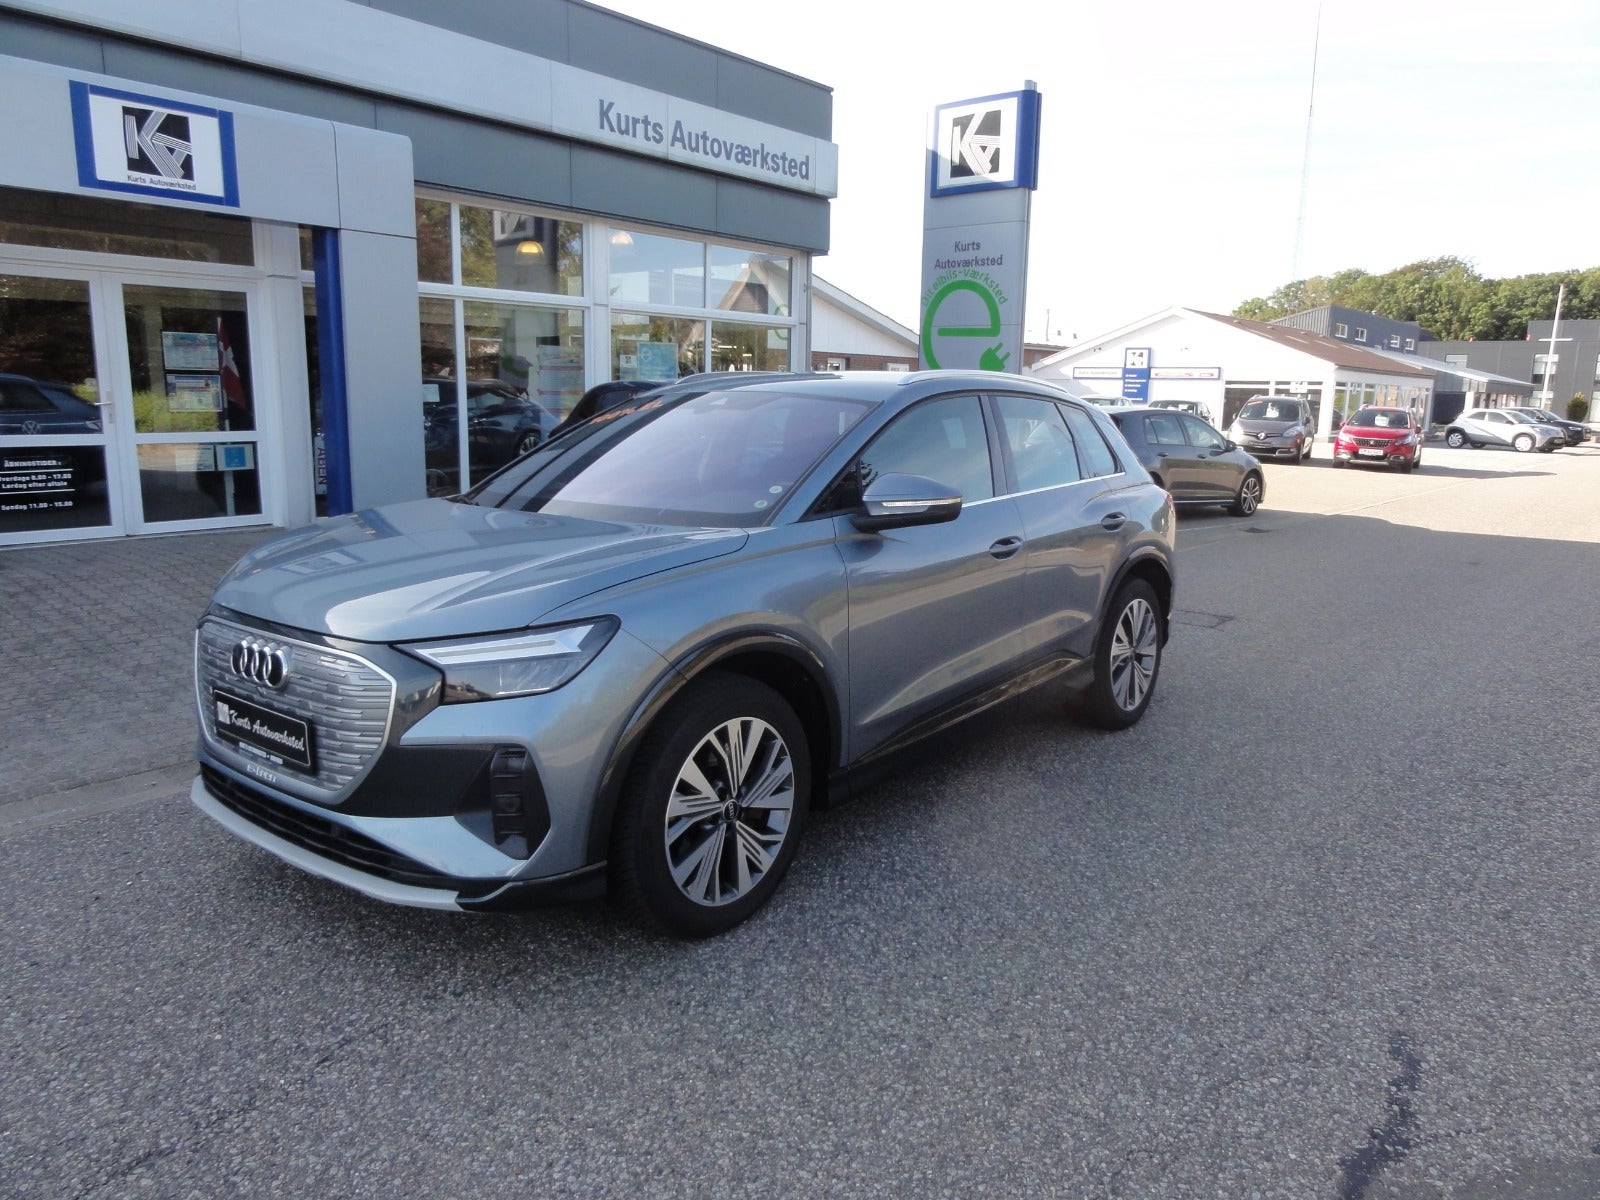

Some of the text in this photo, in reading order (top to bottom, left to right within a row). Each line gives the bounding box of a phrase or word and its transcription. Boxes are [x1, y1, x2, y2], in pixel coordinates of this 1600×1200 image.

[598, 98, 810, 181] Kurts Autoværksted
[127, 174, 197, 191] Kurts Autoværksted
[954, 240, 981, 253] Kurts
[934, 254, 1003, 269] Autoværksted
[229, 709, 251, 730] Kurts
